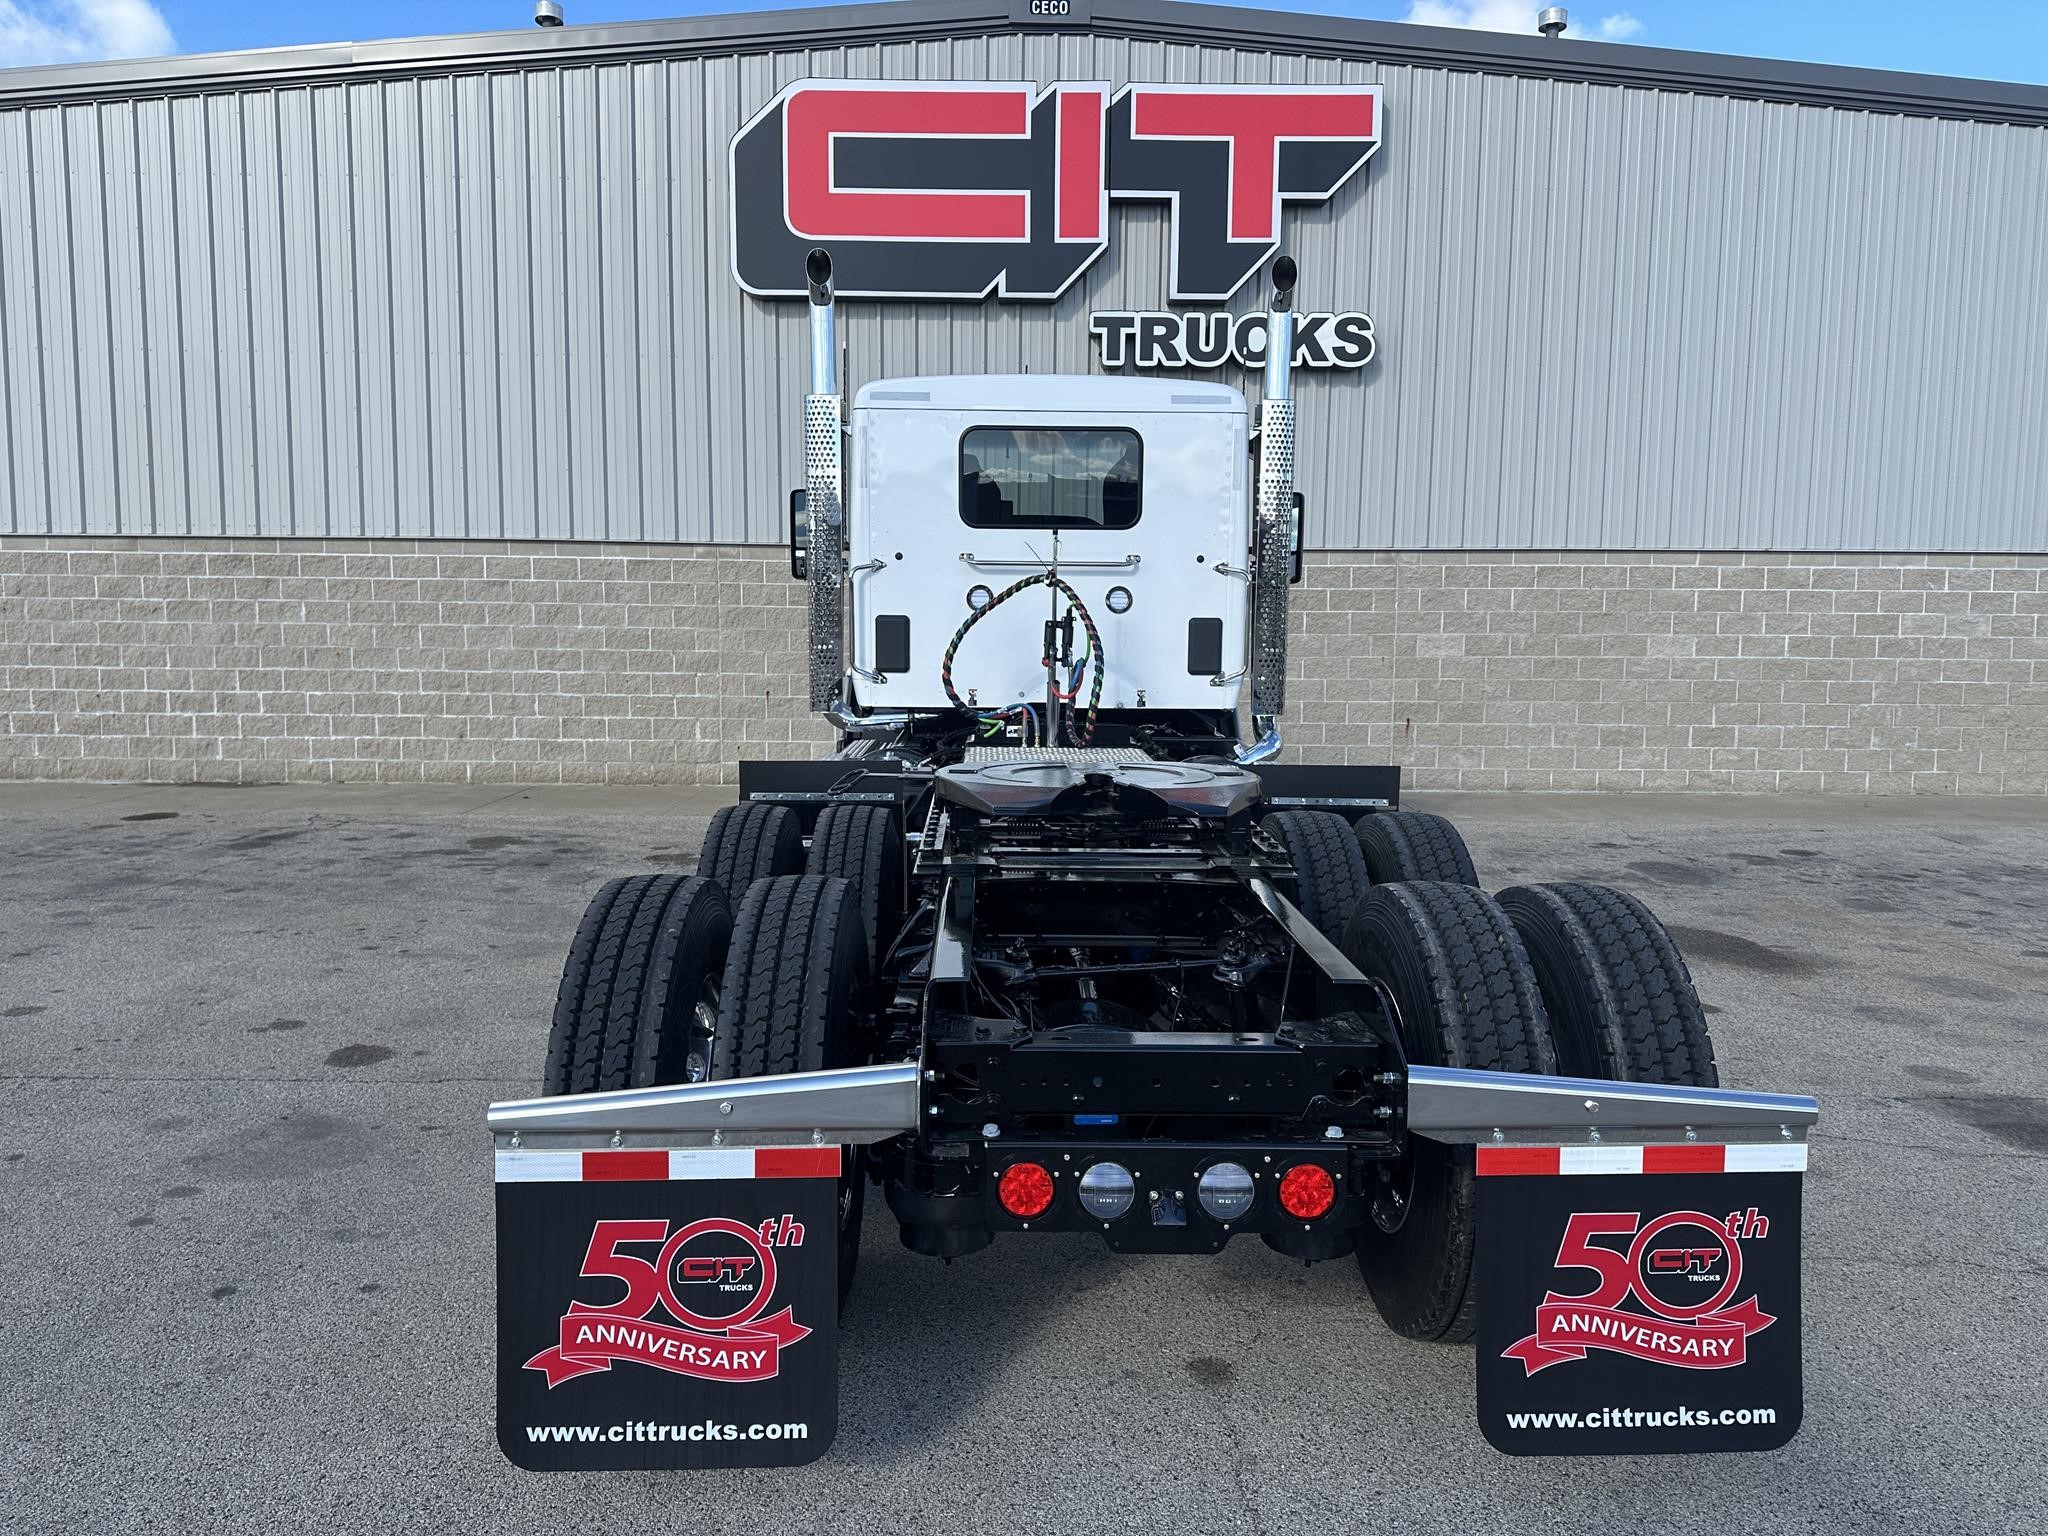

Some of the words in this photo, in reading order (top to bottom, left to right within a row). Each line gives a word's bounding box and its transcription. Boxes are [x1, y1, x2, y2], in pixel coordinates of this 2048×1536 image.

[1031, 0, 1069, 14] CECO
[729, 78, 1383, 302] CIT
[676, 1257, 755, 1283] CIT
[1647, 1248, 1722, 1274] CIT
[719, 1284, 754, 1292] TRUCKS
[1687, 1274, 1721, 1282] TRUCKS
[575, 1324, 767, 1370] ANNIVERSARY
[1551, 1313, 1735, 1358] ANNIVERSARY
[1506, 1406, 1776, 1428] www.cittrucks.com
[526, 1420, 808, 1442] www.cittrucks.com
